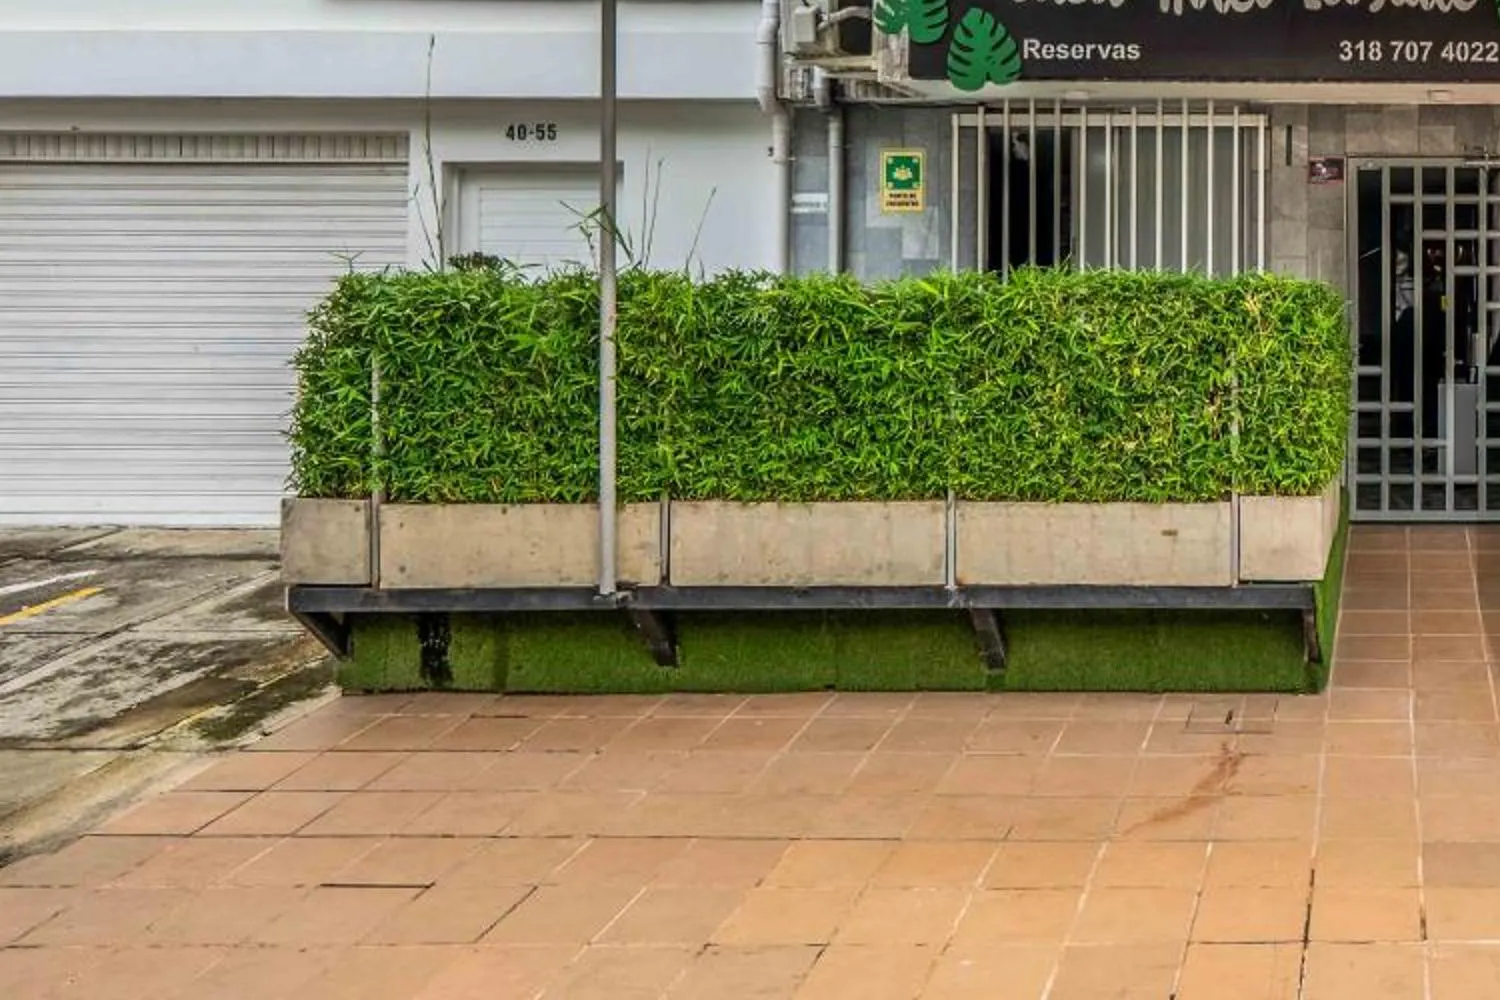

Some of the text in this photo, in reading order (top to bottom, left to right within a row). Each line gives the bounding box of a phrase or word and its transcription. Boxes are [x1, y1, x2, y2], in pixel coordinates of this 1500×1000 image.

[1022, 38, 1141, 60] Reservas
[1339, 40, 1499, 63] 318 707 4022
[505, 123, 558, 141] 40-55
